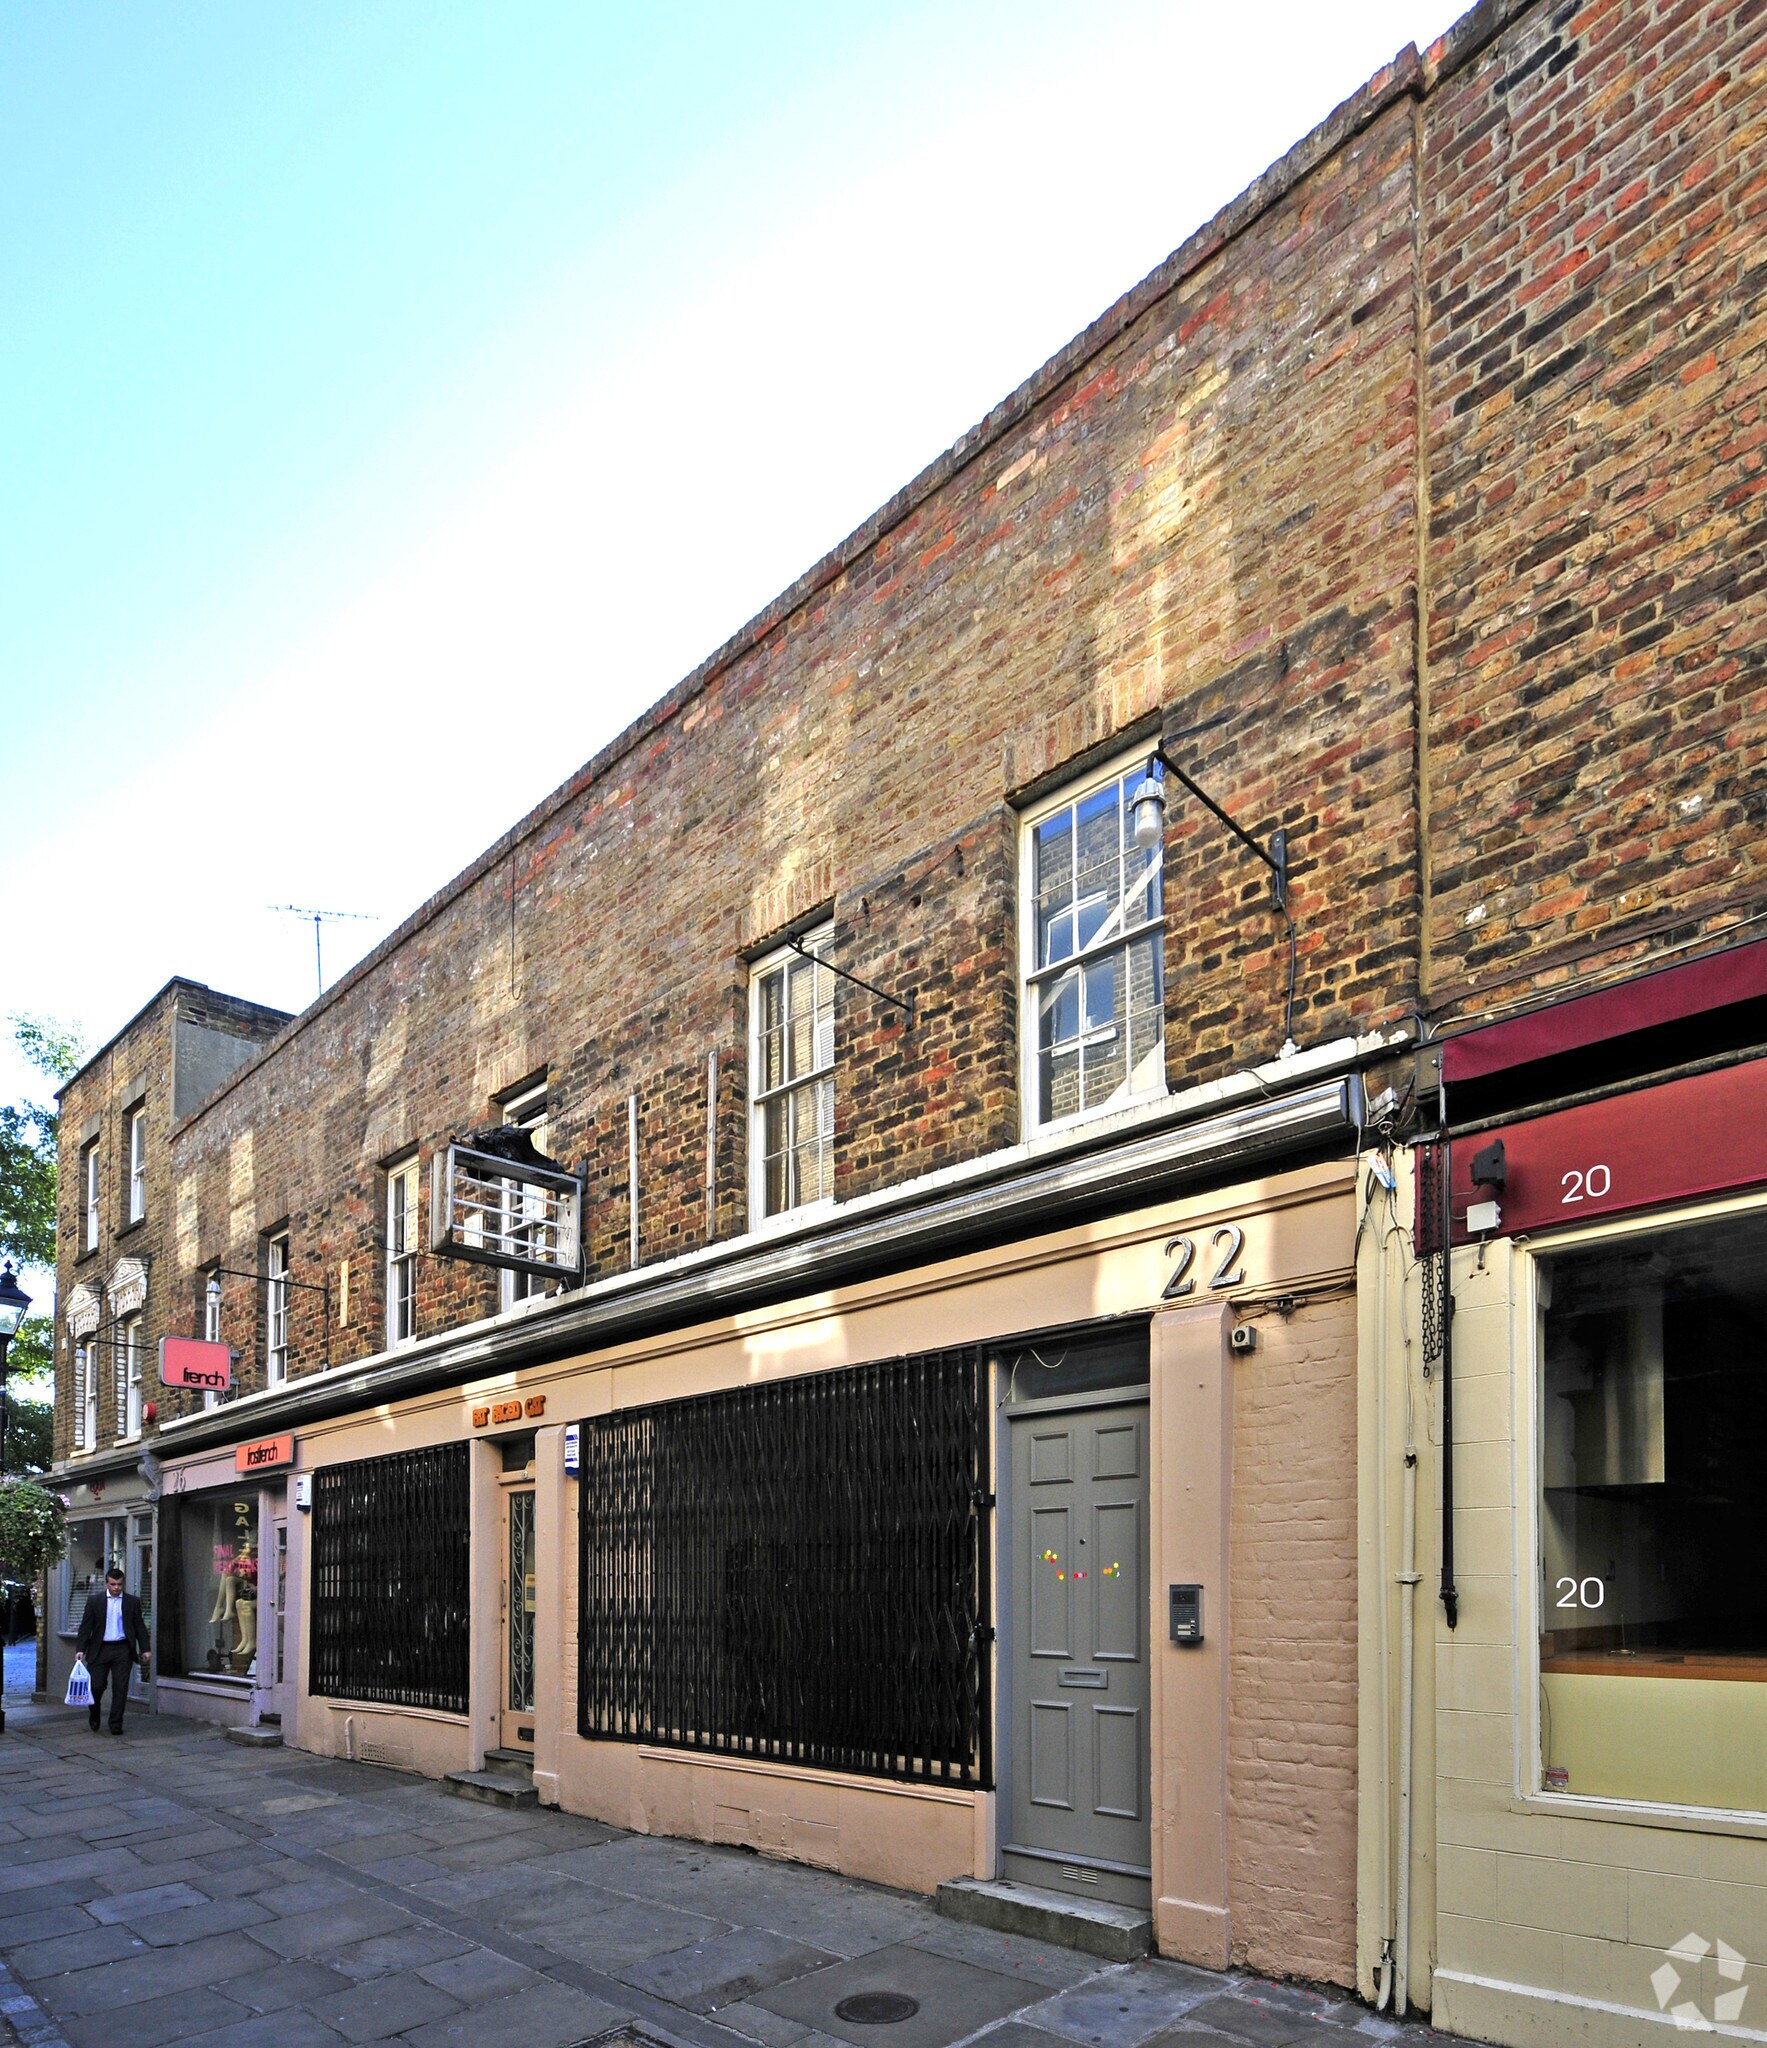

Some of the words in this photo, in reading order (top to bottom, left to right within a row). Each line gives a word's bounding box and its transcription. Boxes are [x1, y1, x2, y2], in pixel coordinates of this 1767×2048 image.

[1561, 1164, 1611, 1204] 20
[1160, 1223, 1245, 1300] 22
[183, 1367, 225, 1387] french
[473, 1407, 490, 1428] FAT
[492, 1401, 522, 1424] FACED
[525, 1395, 546, 1418] CAT
[172, 1466, 187, 1493] 26
[1556, 1576, 1605, 1609] 20
